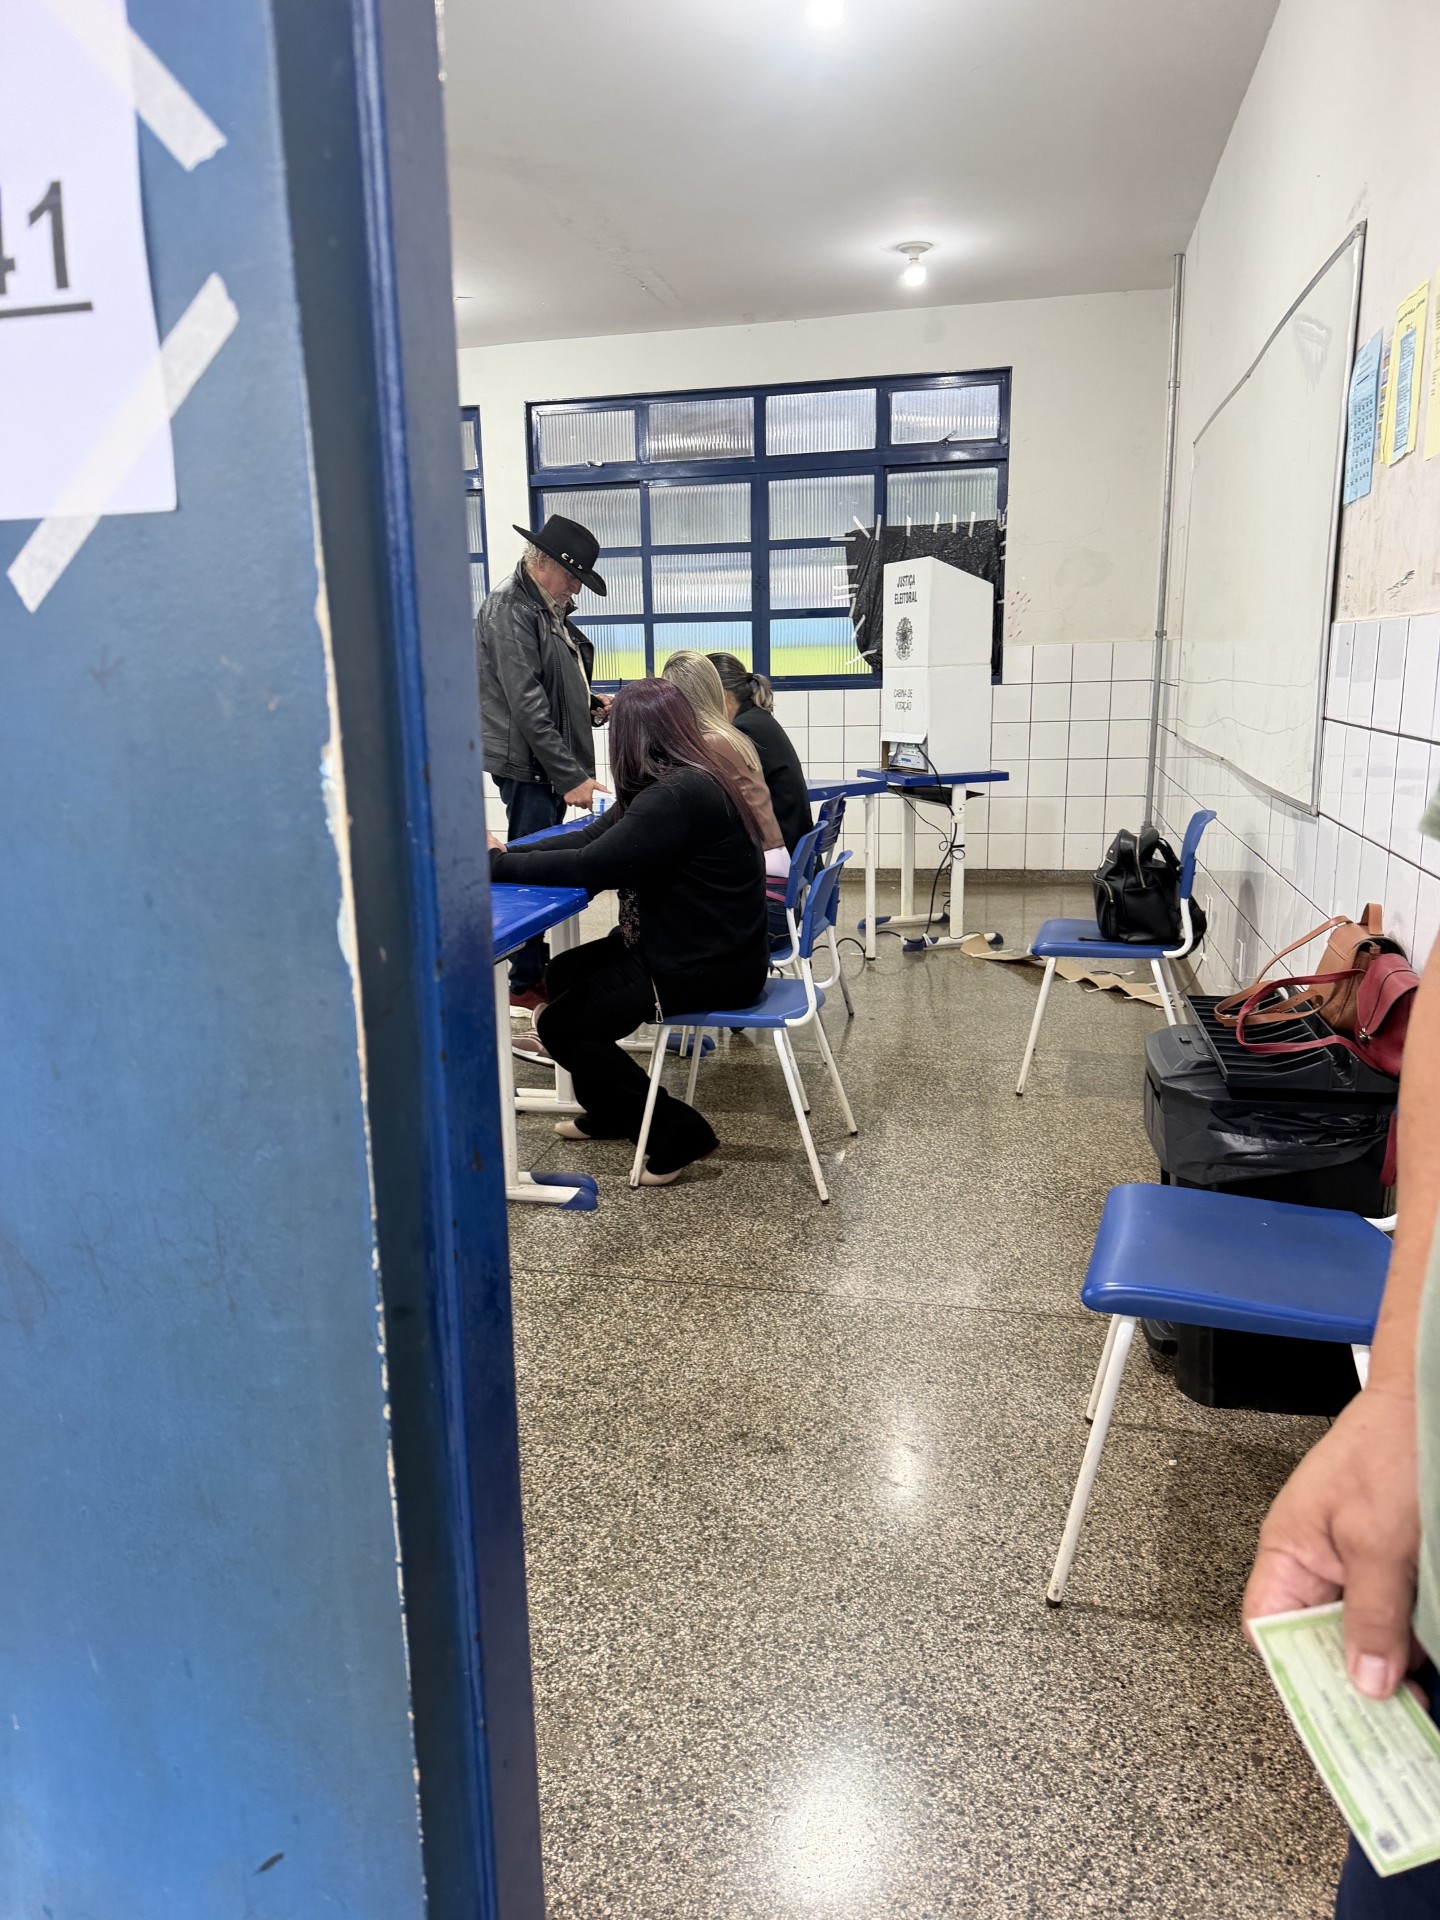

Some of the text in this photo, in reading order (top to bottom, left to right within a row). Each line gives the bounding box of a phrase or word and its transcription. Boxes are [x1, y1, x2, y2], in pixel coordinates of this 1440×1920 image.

[0, 180, 70, 295] 1
[897, 574, 916, 589] JUSTIÇA
[894, 591, 918, 605] ELEITORAL
[907, 689, 913, 698] DE
[895, 700, 912, 712] VOTAÇÃO
